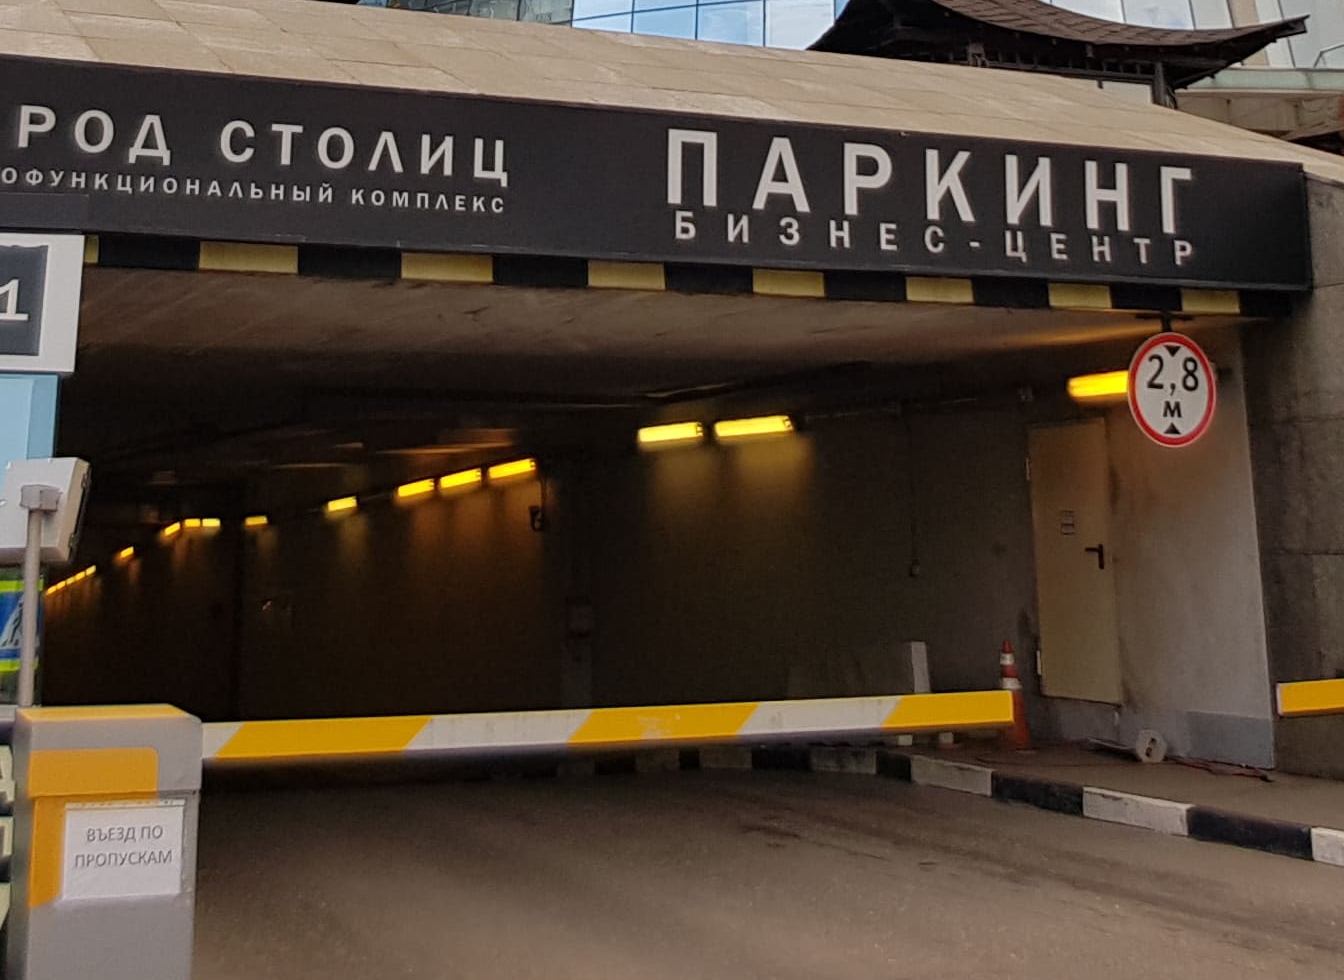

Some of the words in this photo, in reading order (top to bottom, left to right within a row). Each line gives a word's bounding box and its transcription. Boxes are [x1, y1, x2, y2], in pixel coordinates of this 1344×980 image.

[220, 120, 508, 188] СТОЛИЦ
[351, 188, 505, 214] КОМПЛЕКС
[666, 128, 1193, 234] ПАРКИНГ
[674, 210, 1194, 268] БИЗНЕС-ЦЕНТР
[1146, 354, 1199, 396] 2,8
[86, 825, 136, 843] ВЪЕЗД
[140, 825, 164, 840] ПО
[74, 850, 173, 869] ПРОПУСКАМ
